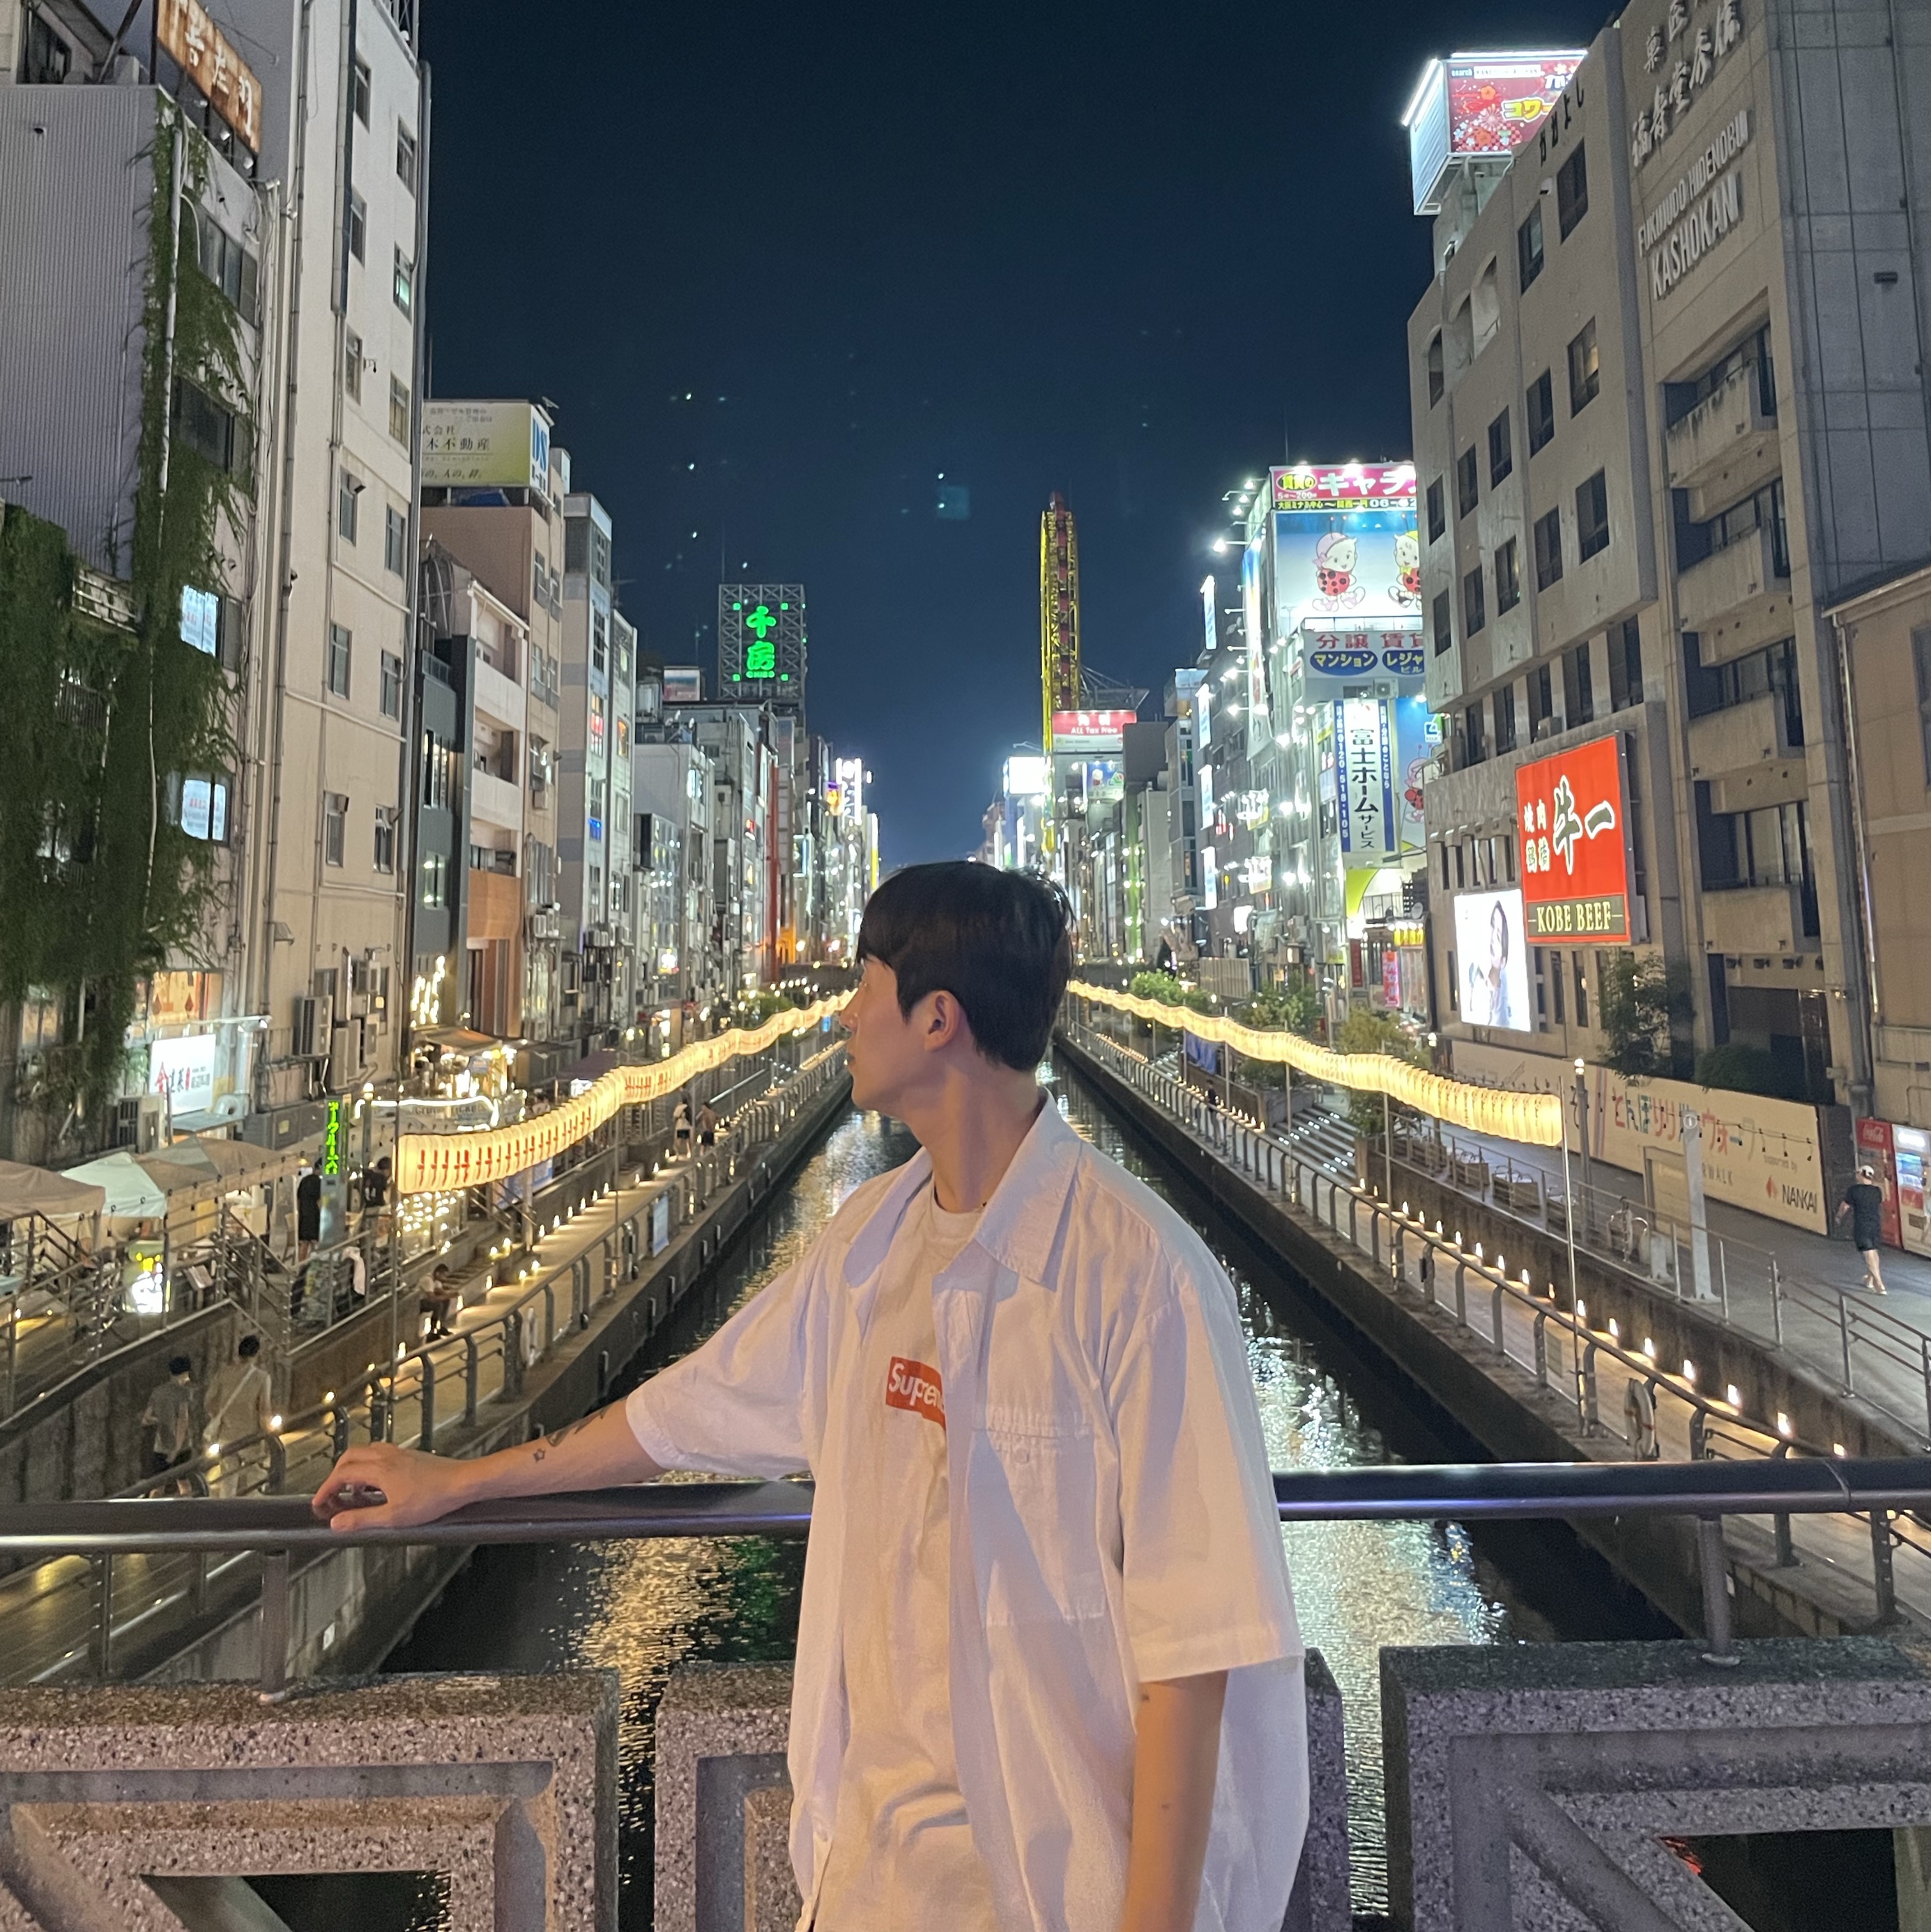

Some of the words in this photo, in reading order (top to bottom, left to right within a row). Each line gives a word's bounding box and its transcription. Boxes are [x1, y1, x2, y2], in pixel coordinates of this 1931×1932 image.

[1651, 173, 1739, 300] KASHOKAN
[1318, 471, 1416, 496] キャラ
[1317, 634, 1369, 649] 分譲
[1314, 653, 1374, 668] マンション
[1553, 774, 1615, 875] 牛一
[1536, 905, 1573, 933] KOBE
[1575, 901, 1612, 931] BEEF
[1782, 1184, 1817, 1214] NANKAI
